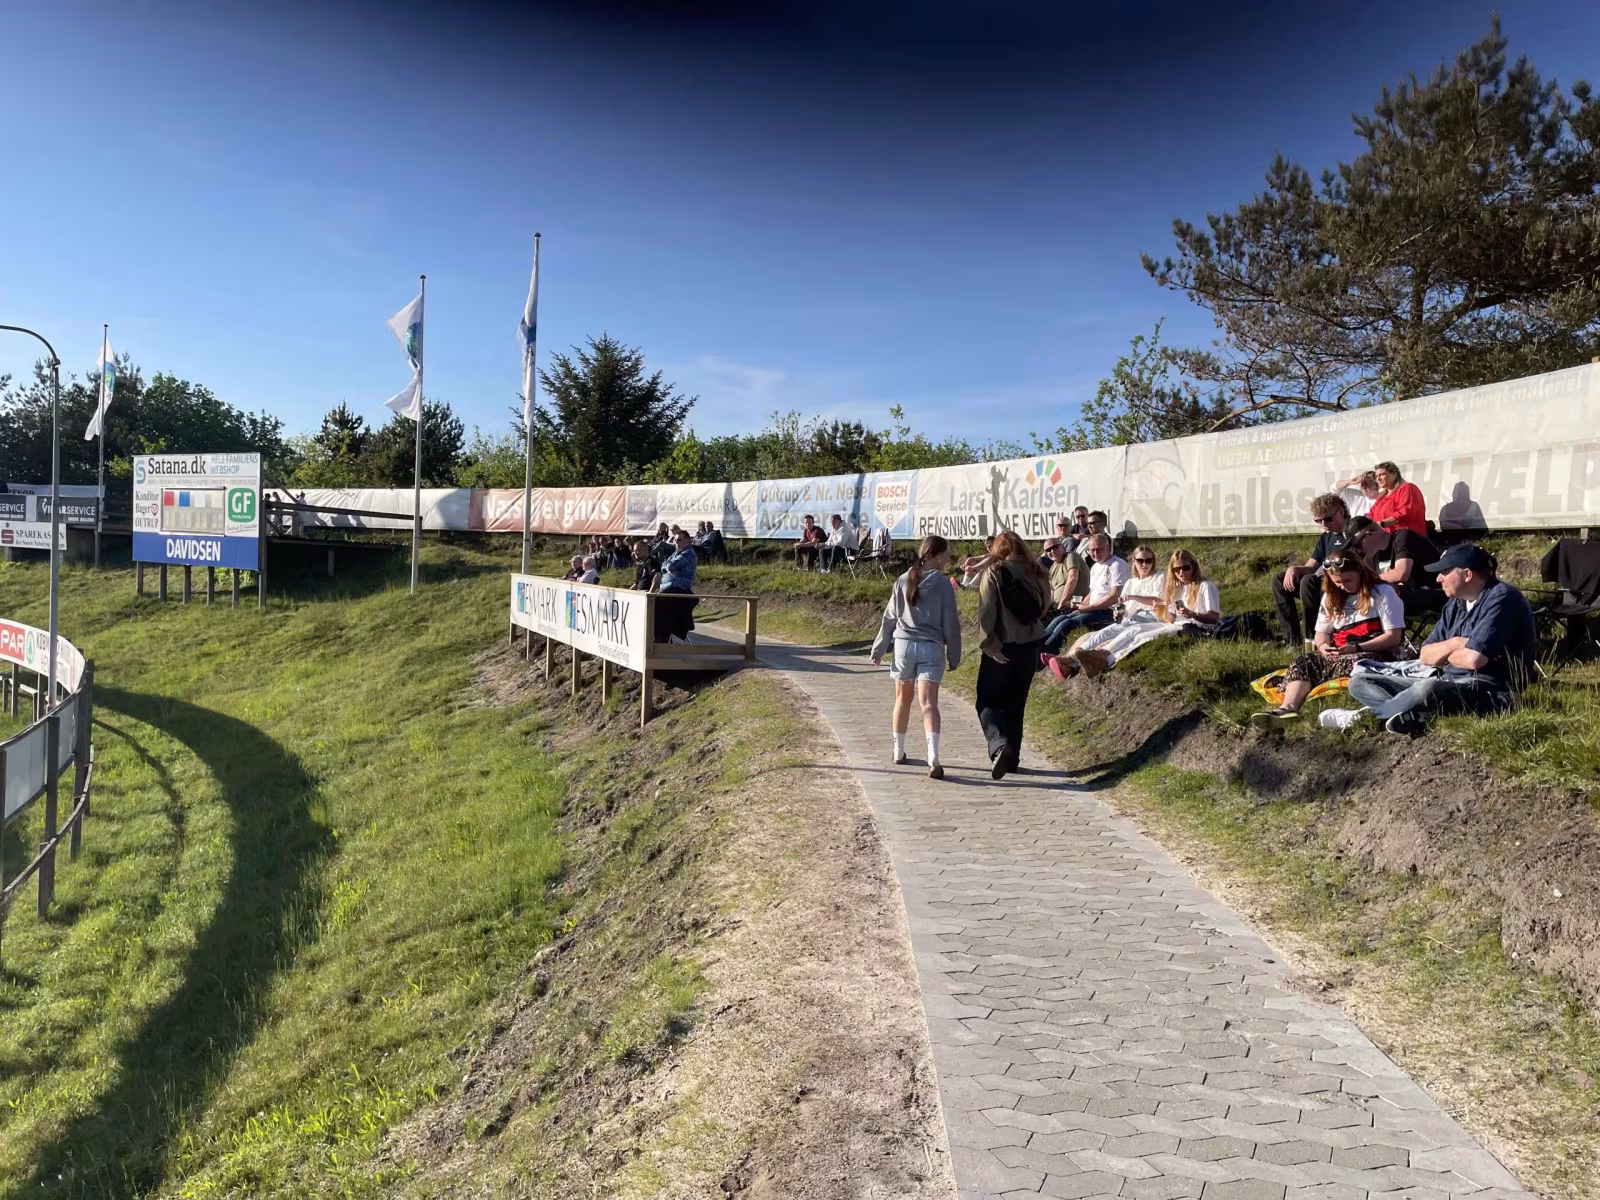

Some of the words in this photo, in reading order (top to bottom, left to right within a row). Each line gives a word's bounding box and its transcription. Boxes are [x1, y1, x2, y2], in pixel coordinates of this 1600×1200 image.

[148, 456, 207, 475] Satana.dk
[226, 454, 258, 464] FAMILIENS
[210, 465, 240, 475] WEBSHOP
[135, 491, 160, 501] Konditor
[816, 483, 833, 500] Nr.
[836, 481, 873, 501] Nebel
[877, 484, 908, 498] BOSCH
[950, 485, 985, 512] Lars
[1003, 477, 1079, 511] Karlsen
[1199, 474, 1316, 527] Halles
[42, 501, 96, 516] VIRSERVICE
[135, 503, 151, 516] Bager
[231, 491, 252, 514] GF
[481, 493, 611, 528] Næsjerghus
[676, 499, 738, 512] AXELGAARD
[876, 500, 907, 512] Service
[135, 518, 159, 529] OUTRUP
[759, 506, 870, 531] Autoserice
[919, 514, 977, 537] RENSNING
[15, 530, 64, 540] SPAREKASN
[166, 538, 221, 562] DAVIDSEN
[525, 583, 557, 623] ESMARK
[576, 593, 630, 647] ESMARK
[0, 629, 24, 655] PAR
